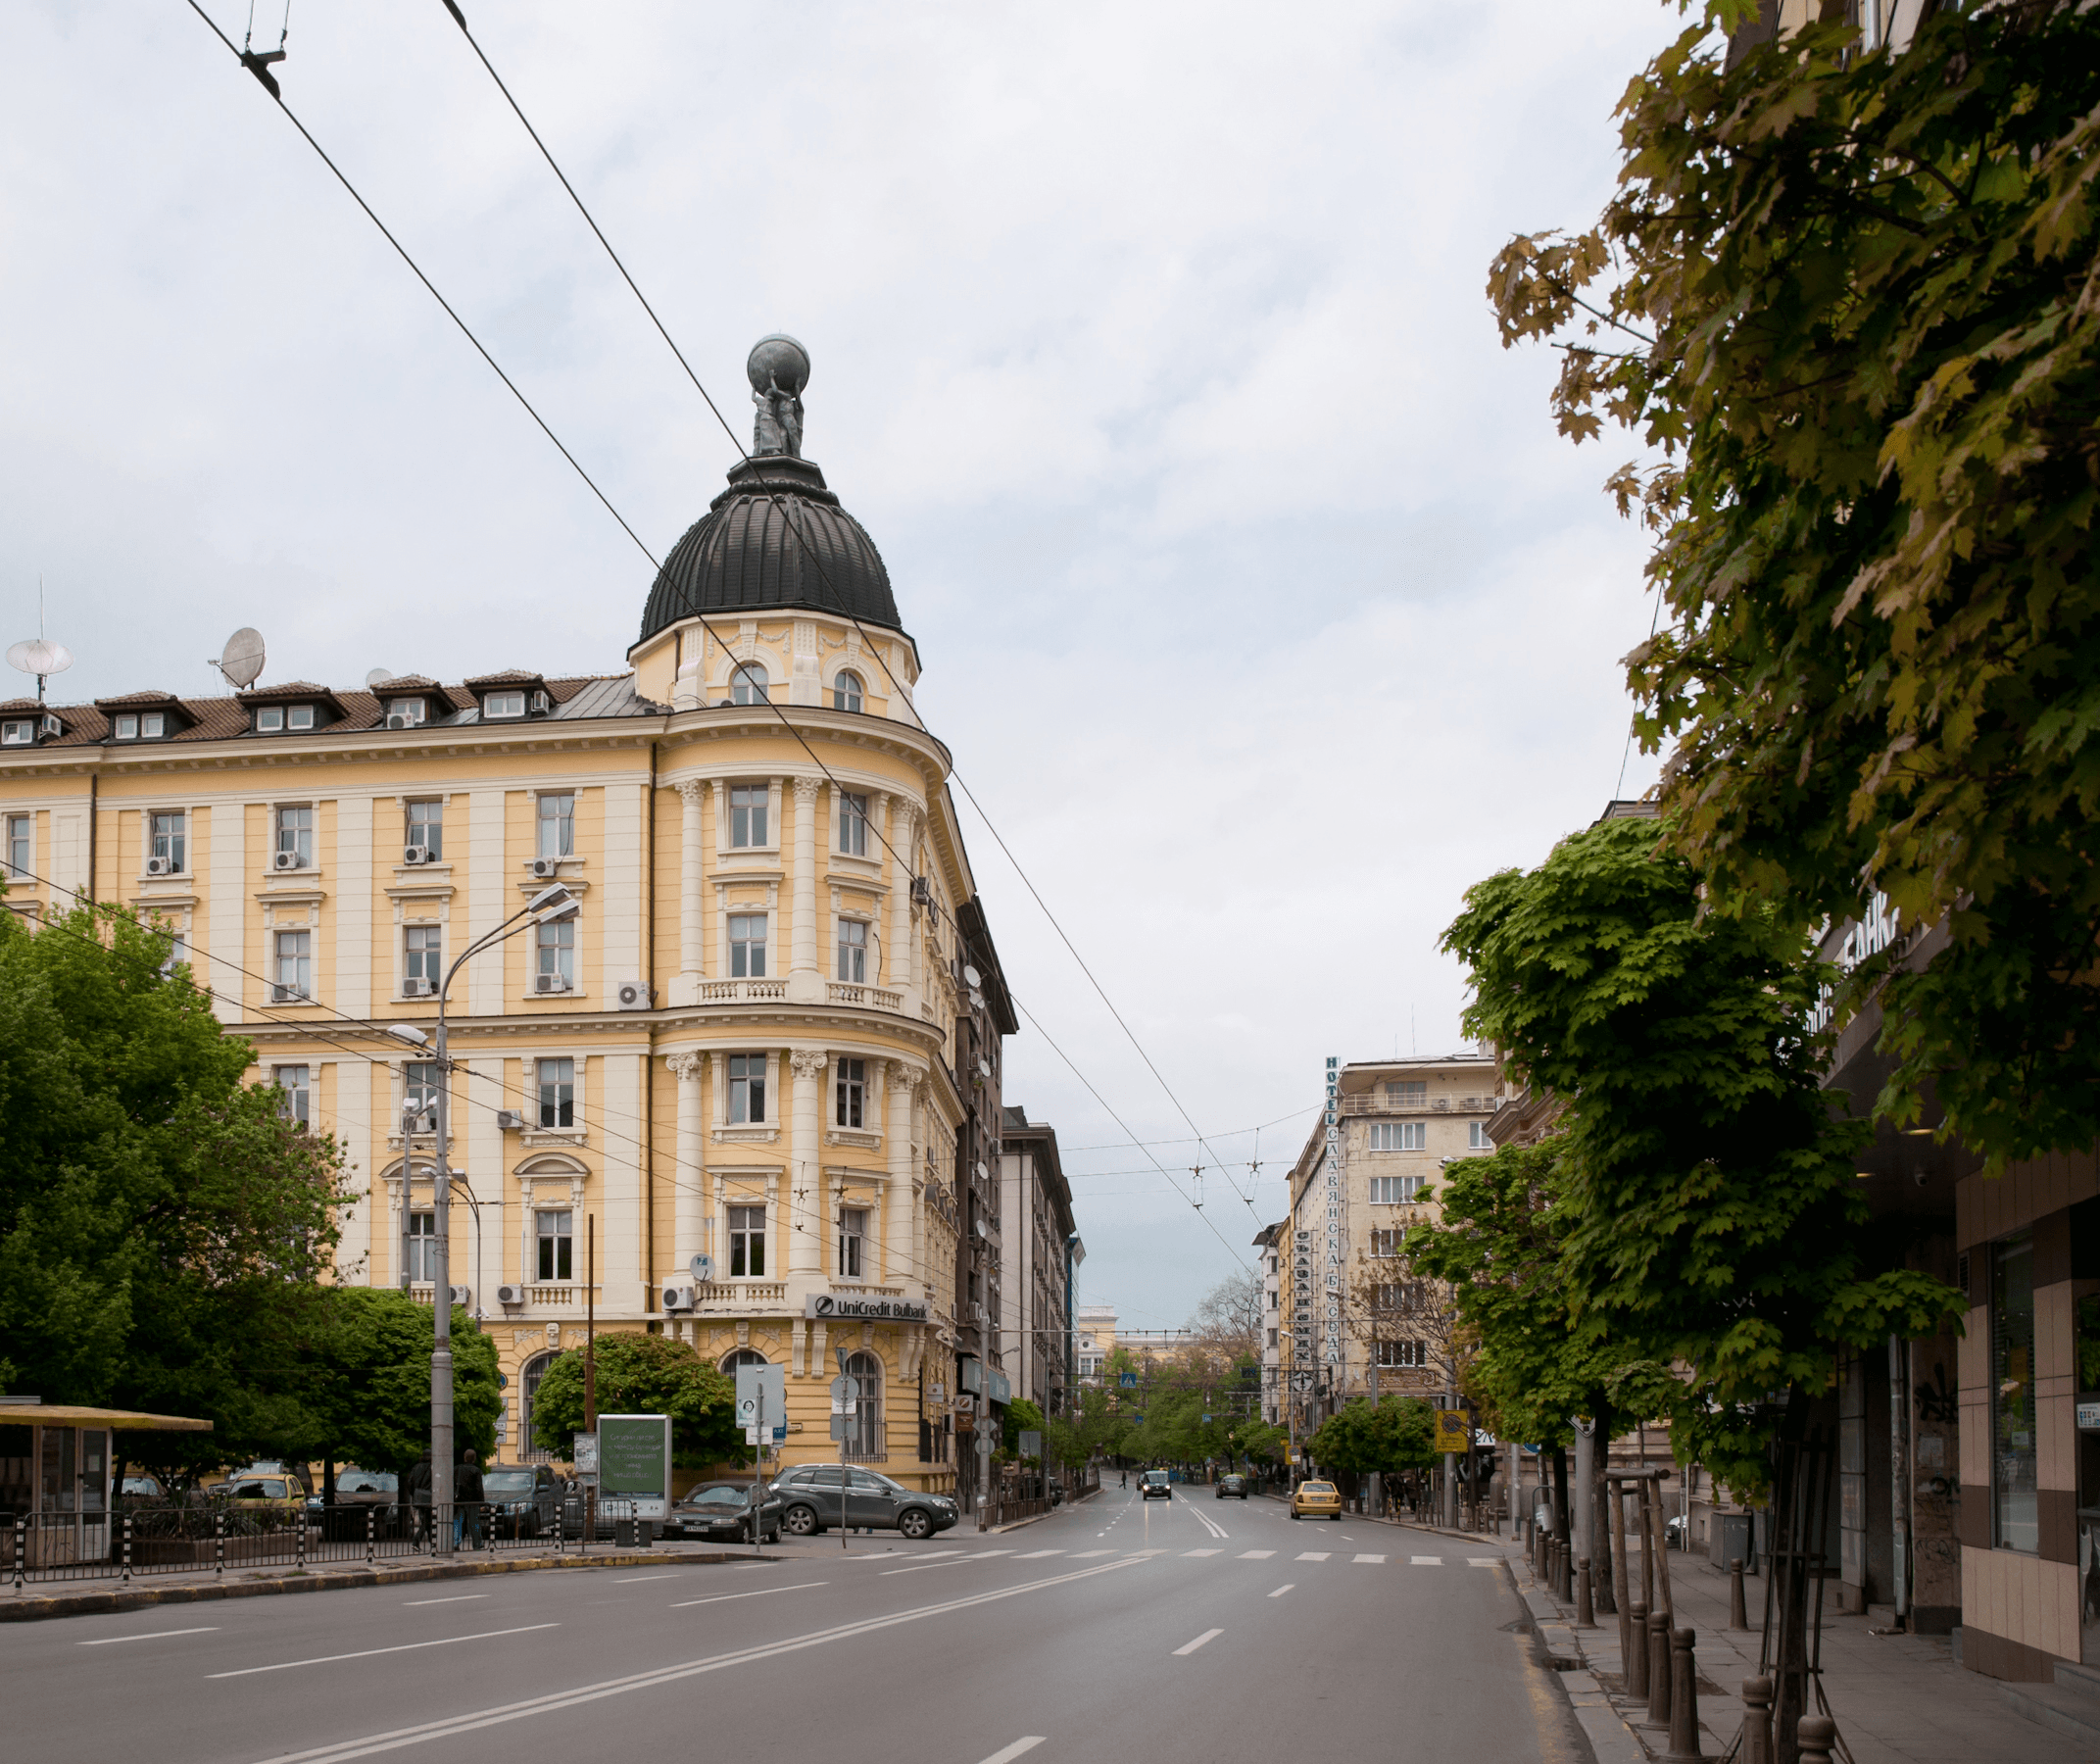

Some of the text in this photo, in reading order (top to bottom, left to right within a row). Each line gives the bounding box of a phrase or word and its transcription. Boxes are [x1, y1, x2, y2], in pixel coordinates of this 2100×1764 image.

[1326, 1057, 1337, 1124] HOTEL
[1328, 1129, 1338, 1265] СЛАВЯНСКА
[838, 1300, 928, 1319] UniCredit Bulbank
